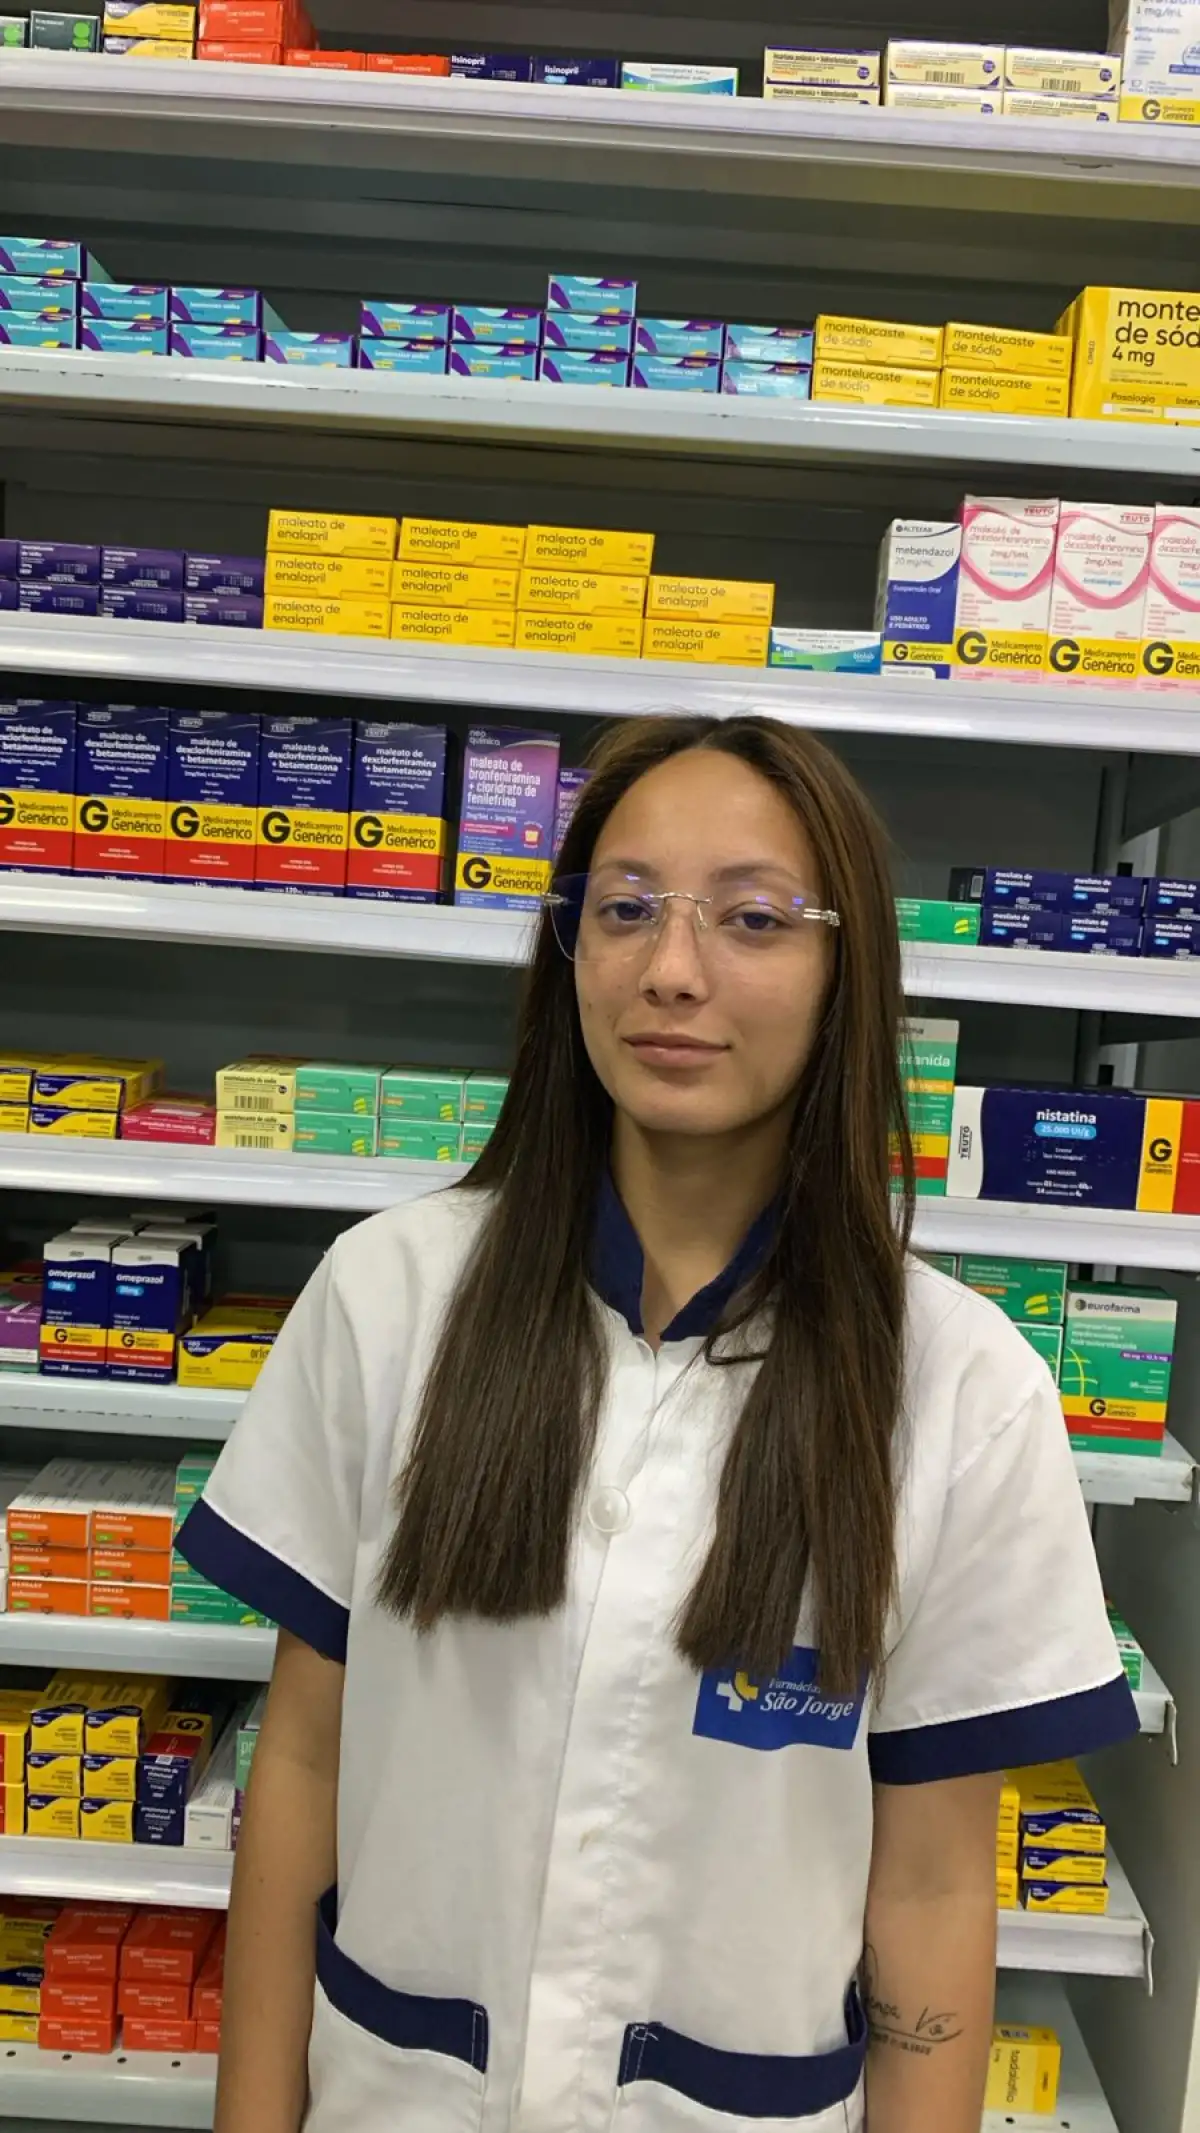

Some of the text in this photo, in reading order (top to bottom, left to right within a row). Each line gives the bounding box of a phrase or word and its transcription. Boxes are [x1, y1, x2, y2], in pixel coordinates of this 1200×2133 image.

[544, 65, 579, 76] lisinopril
[1142, 100, 1161, 120] G
[1118, 300, 1200, 321] monte
[824, 321, 904, 339] montelucaste
[1116, 321, 1200, 347] de sód
[824, 334, 839, 345] de
[953, 329, 1035, 347] montelucaste
[952, 341, 968, 352] de
[1112, 346, 1154, 366] 4 mg
[822, 365, 901, 382] montelucaste
[820, 378, 836, 389] de
[951, 374, 1032, 390] montelucaste
[949, 386, 965, 396] de
[1111, 392, 1155, 404] Posologia
[278, 518, 345, 530] maleato de
[1120, 515, 1150, 523] TEUTO
[277, 529, 328, 541] enalapril
[410, 525, 477, 539] maleato de
[1106, 534, 1116, 542] de
[409, 538, 460, 550] enalapril
[536, 533, 604, 546] maleato de
[536, 545, 587, 558] enalapril
[896, 546, 954, 556] mebendazol
[275, 559, 342, 572] maleato de
[275, 571, 326, 583] enalapril
[402, 567, 468, 581] maleato de
[401, 580, 452, 592] enalapril
[530, 575, 597, 588] maleato de
[530, 587, 580, 600] enalapril
[659, 583, 726, 596] maleato de
[893, 585, 926, 593] Suspensão
[273, 601, 340, 614] maleato de
[658, 596, 708, 608] enalapril
[272, 613, 324, 626] enalapril
[402, 610, 468, 623] maleato de
[401, 622, 452, 635] enalapril
[526, 617, 593, 631] maleato de
[525, 629, 576, 642] enalapril
[653, 626, 720, 639] maleato de
[653, 638, 704, 650] enalapril
[957, 631, 987, 664] G
[991, 640, 1042, 652] Medicamento
[893, 644, 908, 660] G
[910, 651, 943, 661] Genérico
[990, 650, 1041, 665] Genérico
[1050, 639, 1080, 672] G
[1084, 648, 1137, 660] Medicamento
[1143, 642, 1173, 675] G
[1082, 658, 1134, 674] Genérico
[6, 725, 53, 734] maleato de
[100, 732, 146, 742] maleato de
[191, 737, 237, 747] maleato de
[85, 739, 160, 752] dexclorfeniramina
[176, 746, 251, 758] dexclorfeniramina
[282, 743, 329, 753] maleato de
[96, 750, 156, 761] betametasona
[268, 751, 342, 763] dexclorfeniramina
[376, 748, 423, 757] maleato de
[187, 755, 247, 766] betametasona
[278, 761, 338, 772] betametasona
[362, 755, 436, 768] dexclorfeniramina
[470, 756, 522, 772] maleato de
[373, 764, 432, 777] betametasona
[468, 769, 541, 785] bronfeniramina
[476, 781, 536, 797] cloridrato de
[467, 792, 517, 808] fenilefrina
[18, 811, 68, 826] Genérico
[80, 799, 108, 832] G
[171, 805, 199, 838] G
[203, 815, 252, 826] Medicamento
[111, 819, 161, 833] Genérico
[202, 823, 252, 840] Genérico
[262, 811, 291, 844] G
[294, 820, 343, 832] Medicamento
[355, 815, 383, 848] G
[387, 825, 436, 836] Medicamento
[293, 829, 343, 845] Genérico
[386, 834, 436, 849] Genérico
[463, 857, 492, 889] G
[493, 875, 542, 890] Genérico
[1036, 1109, 1096, 1124] nistatina
[1042, 1125, 1070, 1134] 25.000
[960, 1126, 971, 1158] TEUTO
[1149, 1138, 1172, 1161] G
[48, 1269, 96, 1279] omeprazol
[116, 1274, 164, 1284] omeprazol
[1088, 1302, 1140, 1314] eurofarma
[54, 1328, 68, 1343] G
[122, 1333, 135, 1347] G
[1090, 1399, 1106, 1416] G
[760, 1692, 854, 1721] São Jorge
